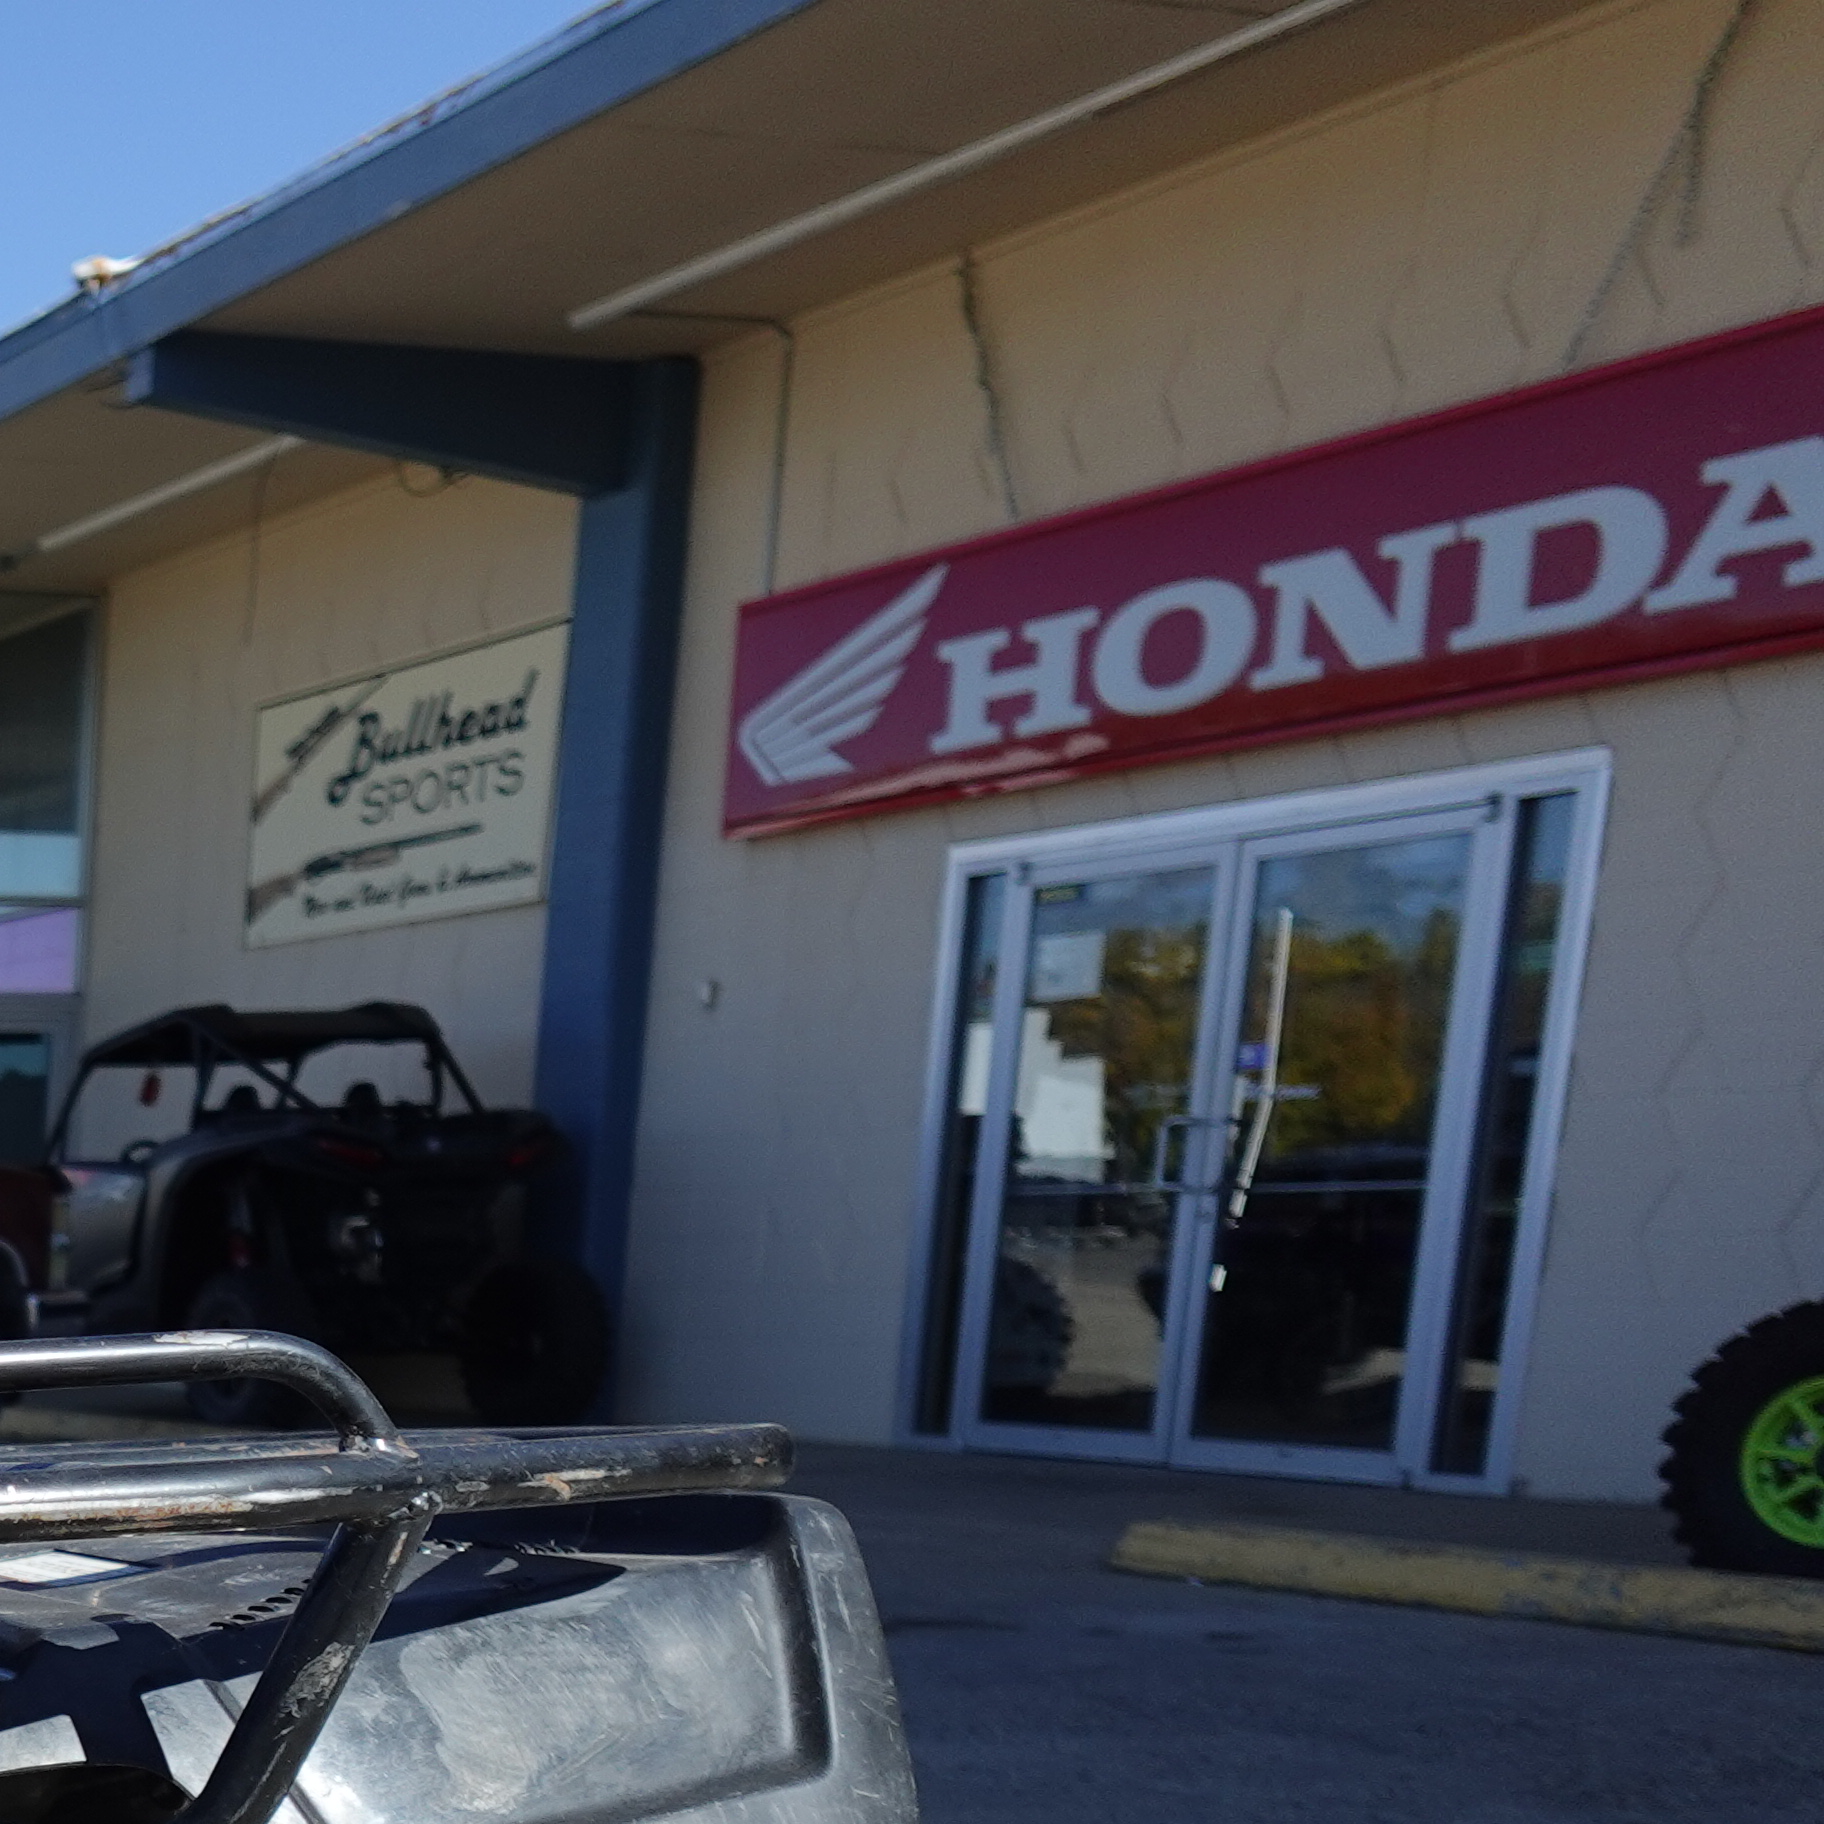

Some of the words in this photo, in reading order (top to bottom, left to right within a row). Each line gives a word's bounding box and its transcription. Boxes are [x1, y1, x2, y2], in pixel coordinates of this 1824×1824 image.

[929, 435, 1824, 755] HONDA
[326, 667, 540, 807] Bullhead
[360, 750, 524, 825] SPORTS
